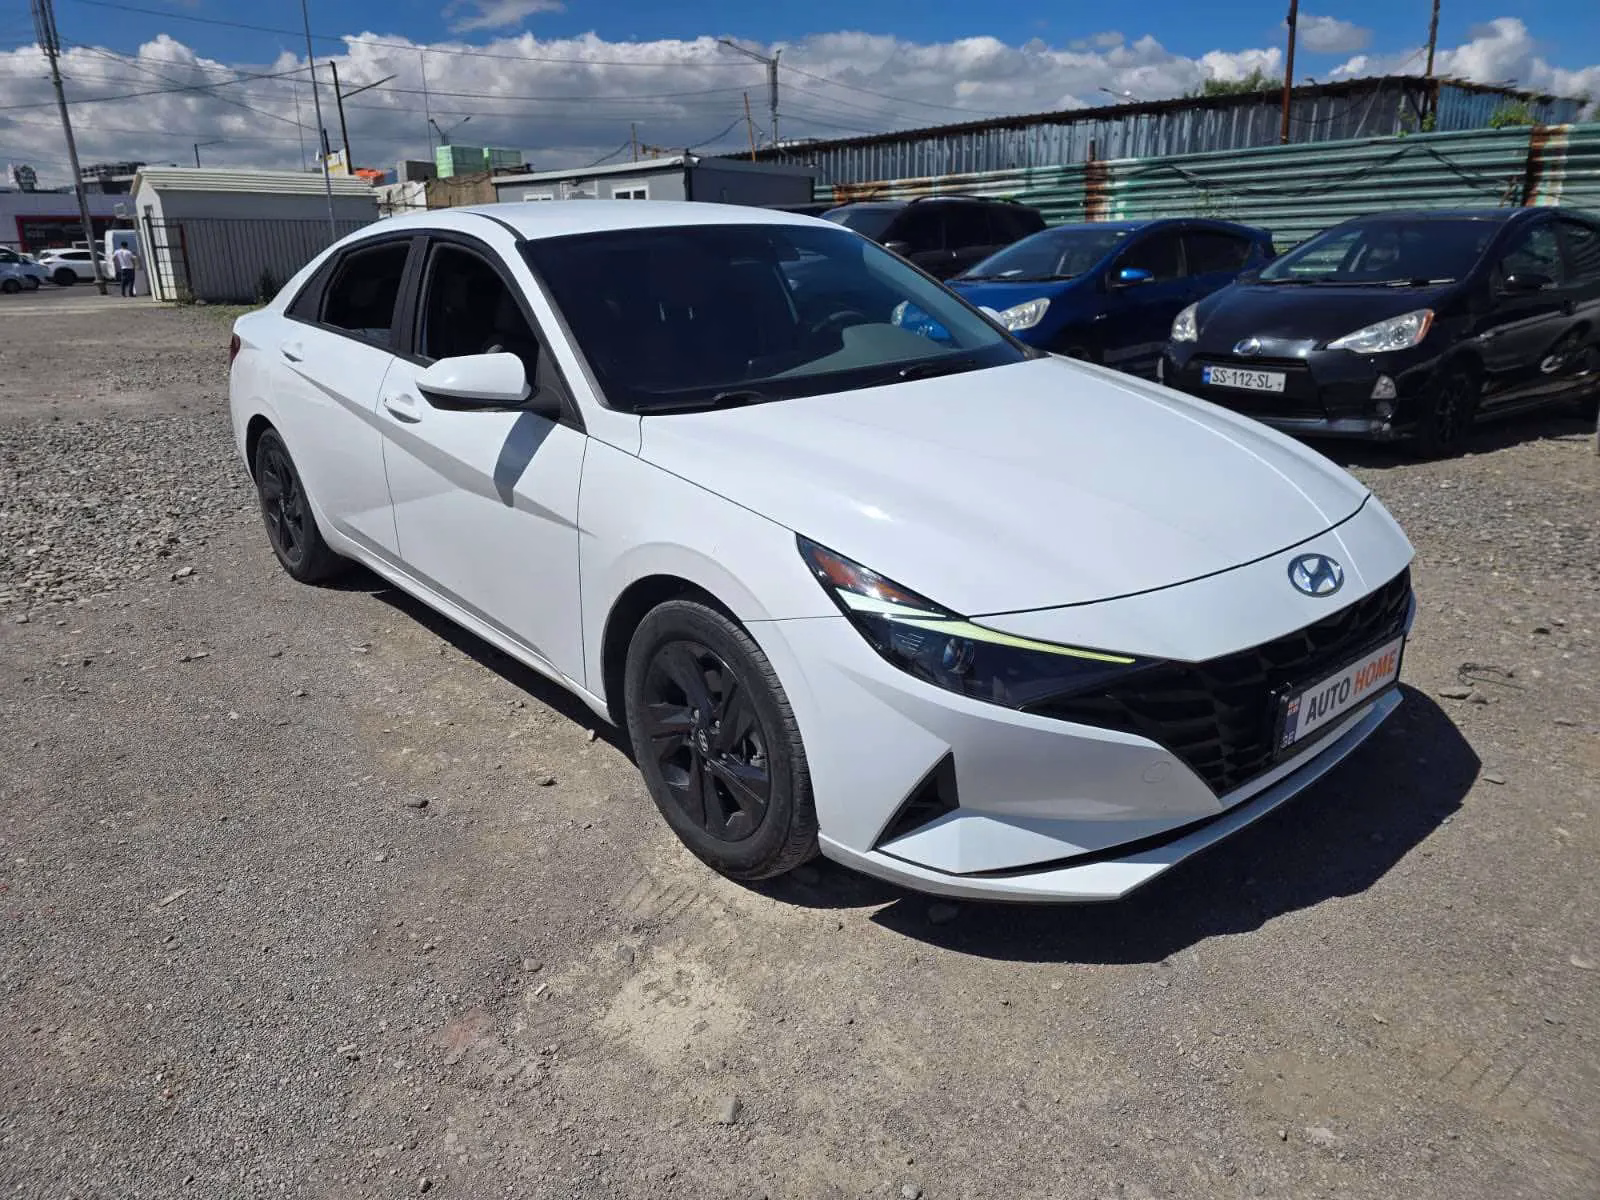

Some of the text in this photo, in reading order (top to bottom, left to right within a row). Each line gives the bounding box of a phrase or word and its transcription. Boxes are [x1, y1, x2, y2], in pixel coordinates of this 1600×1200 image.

[1212, 368, 1272, 389] SS-112-SL
[1305, 648, 1397, 725] AUTO HOME
